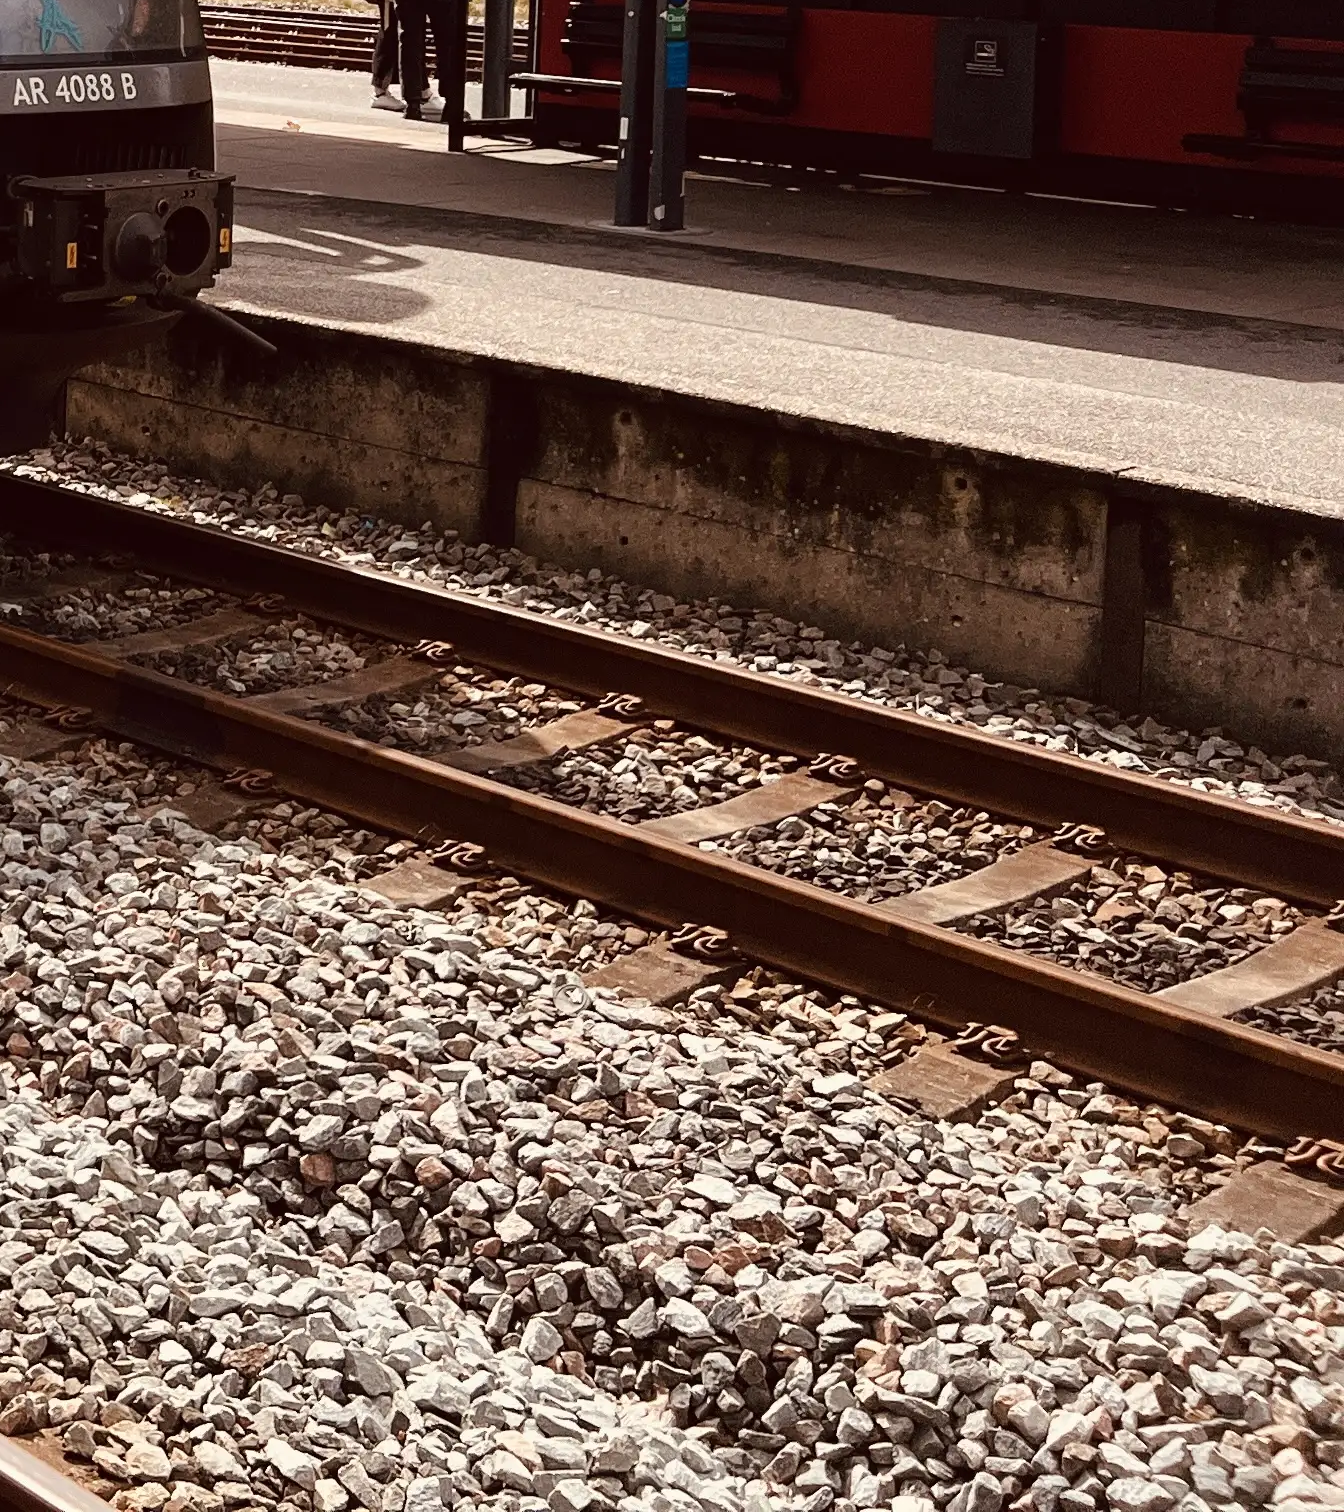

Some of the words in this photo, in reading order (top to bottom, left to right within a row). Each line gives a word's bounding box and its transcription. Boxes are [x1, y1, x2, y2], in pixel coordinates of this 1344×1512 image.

[13, 77, 49, 106] AR
[55, 73, 115, 103] 4088
[120, 72, 137, 100] B
